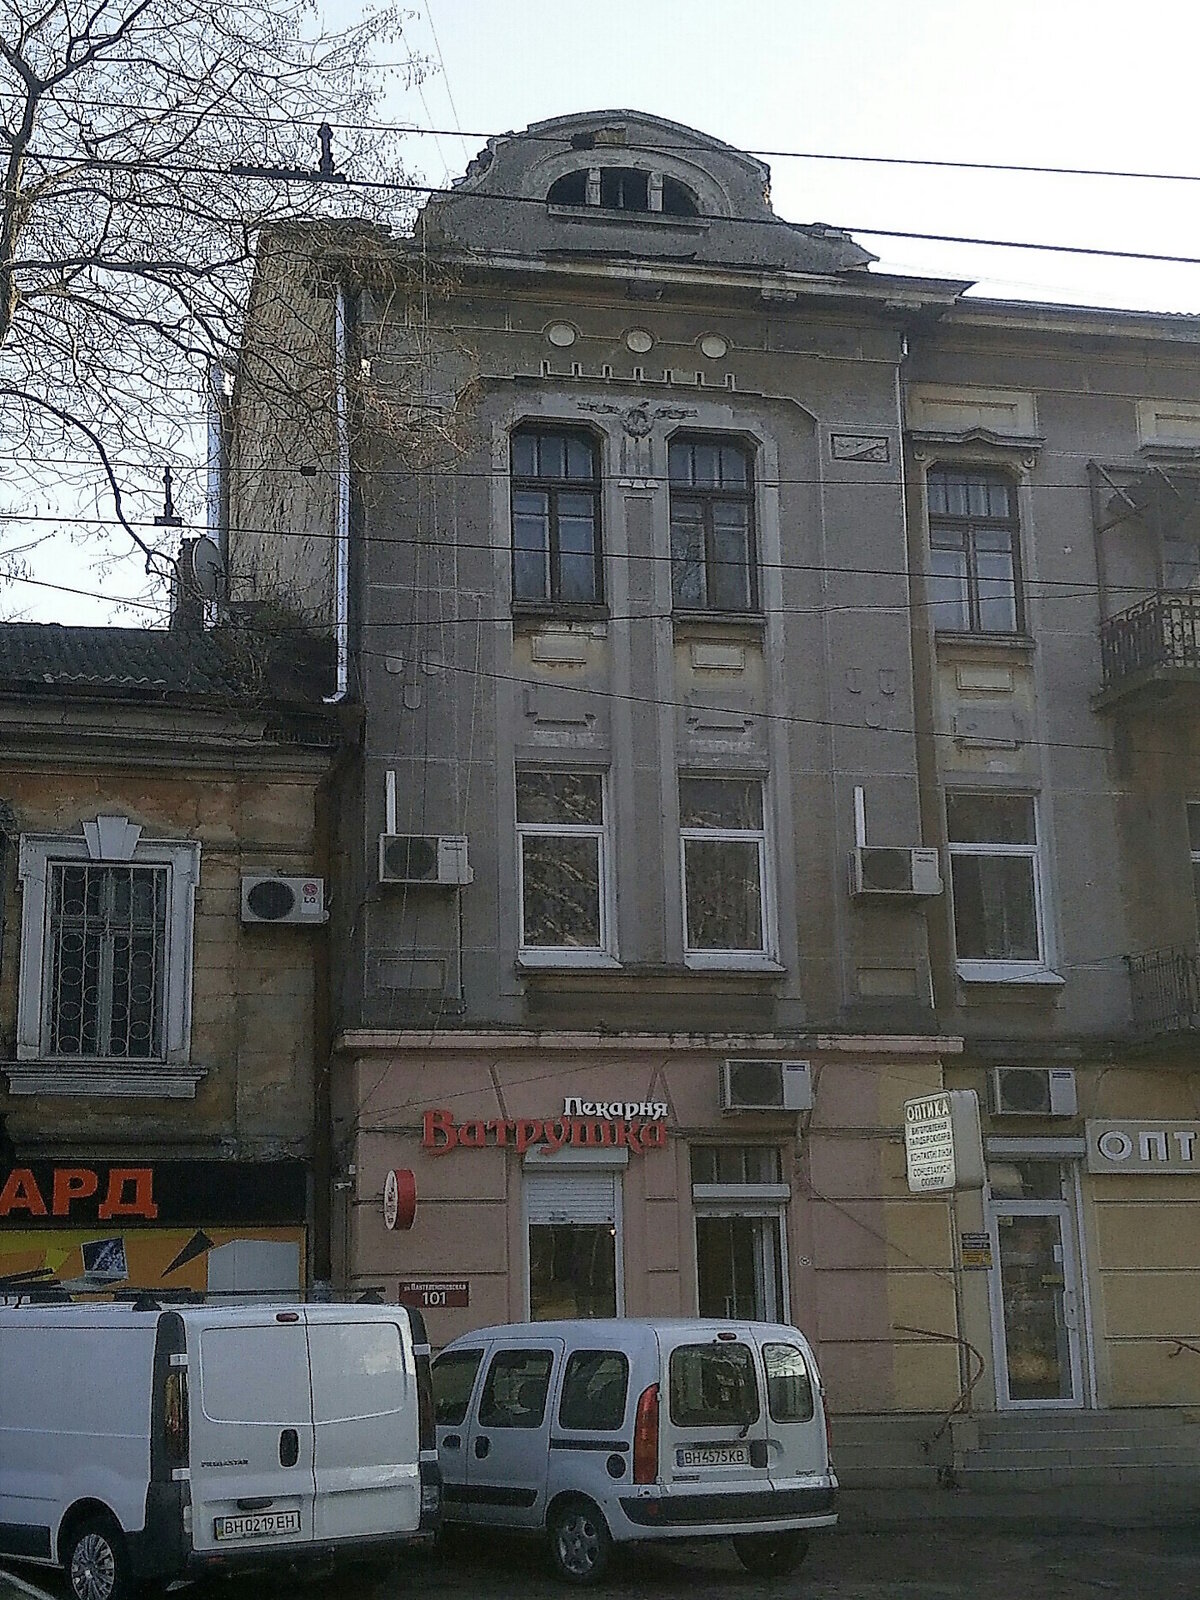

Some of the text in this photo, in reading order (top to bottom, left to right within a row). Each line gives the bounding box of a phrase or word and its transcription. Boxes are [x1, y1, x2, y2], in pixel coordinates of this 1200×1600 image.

[563, 1097, 668, 1120] Пекарня
[906, 1099, 950, 1121] ОПТИКА
[421, 1109, 667, 1156] Ватрушка
[1097, 1130, 1197, 1161] ОПТ
[0, 1168, 158, 1219] АРД
[422, 1291, 446, 1305] 101
